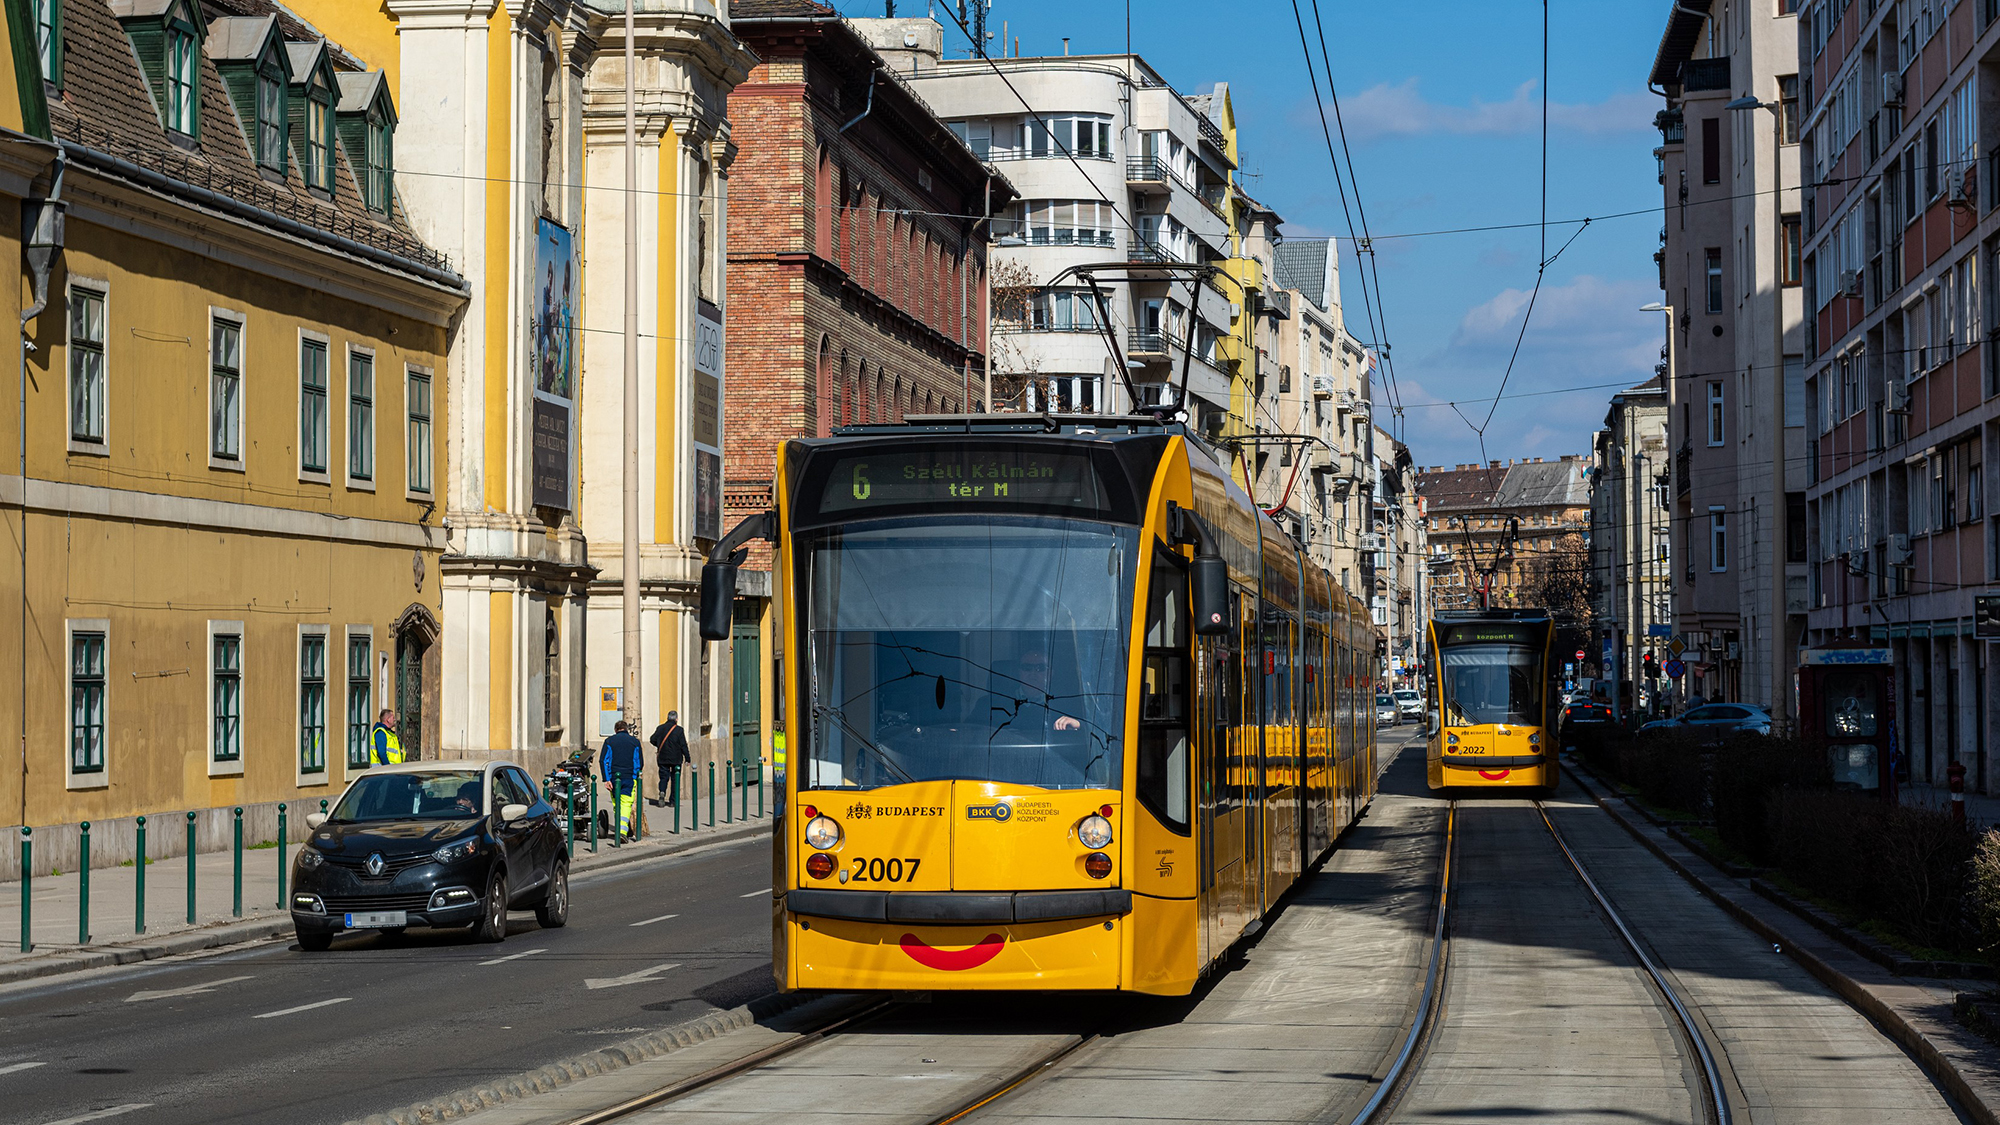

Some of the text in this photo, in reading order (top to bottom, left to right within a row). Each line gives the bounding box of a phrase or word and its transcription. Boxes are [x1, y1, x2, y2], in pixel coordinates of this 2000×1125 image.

[698, 323, 718, 371] 250
[903, 462, 1054, 480] Széll Kálmán
[852, 464, 871, 500] 6
[949, 480, 1008, 497] tér M
[1463, 746, 1485, 754] 2022
[876, 806, 945, 817] BUDAPEST
[971, 808, 993, 817] BKK
[851, 857, 921, 883] 2007
